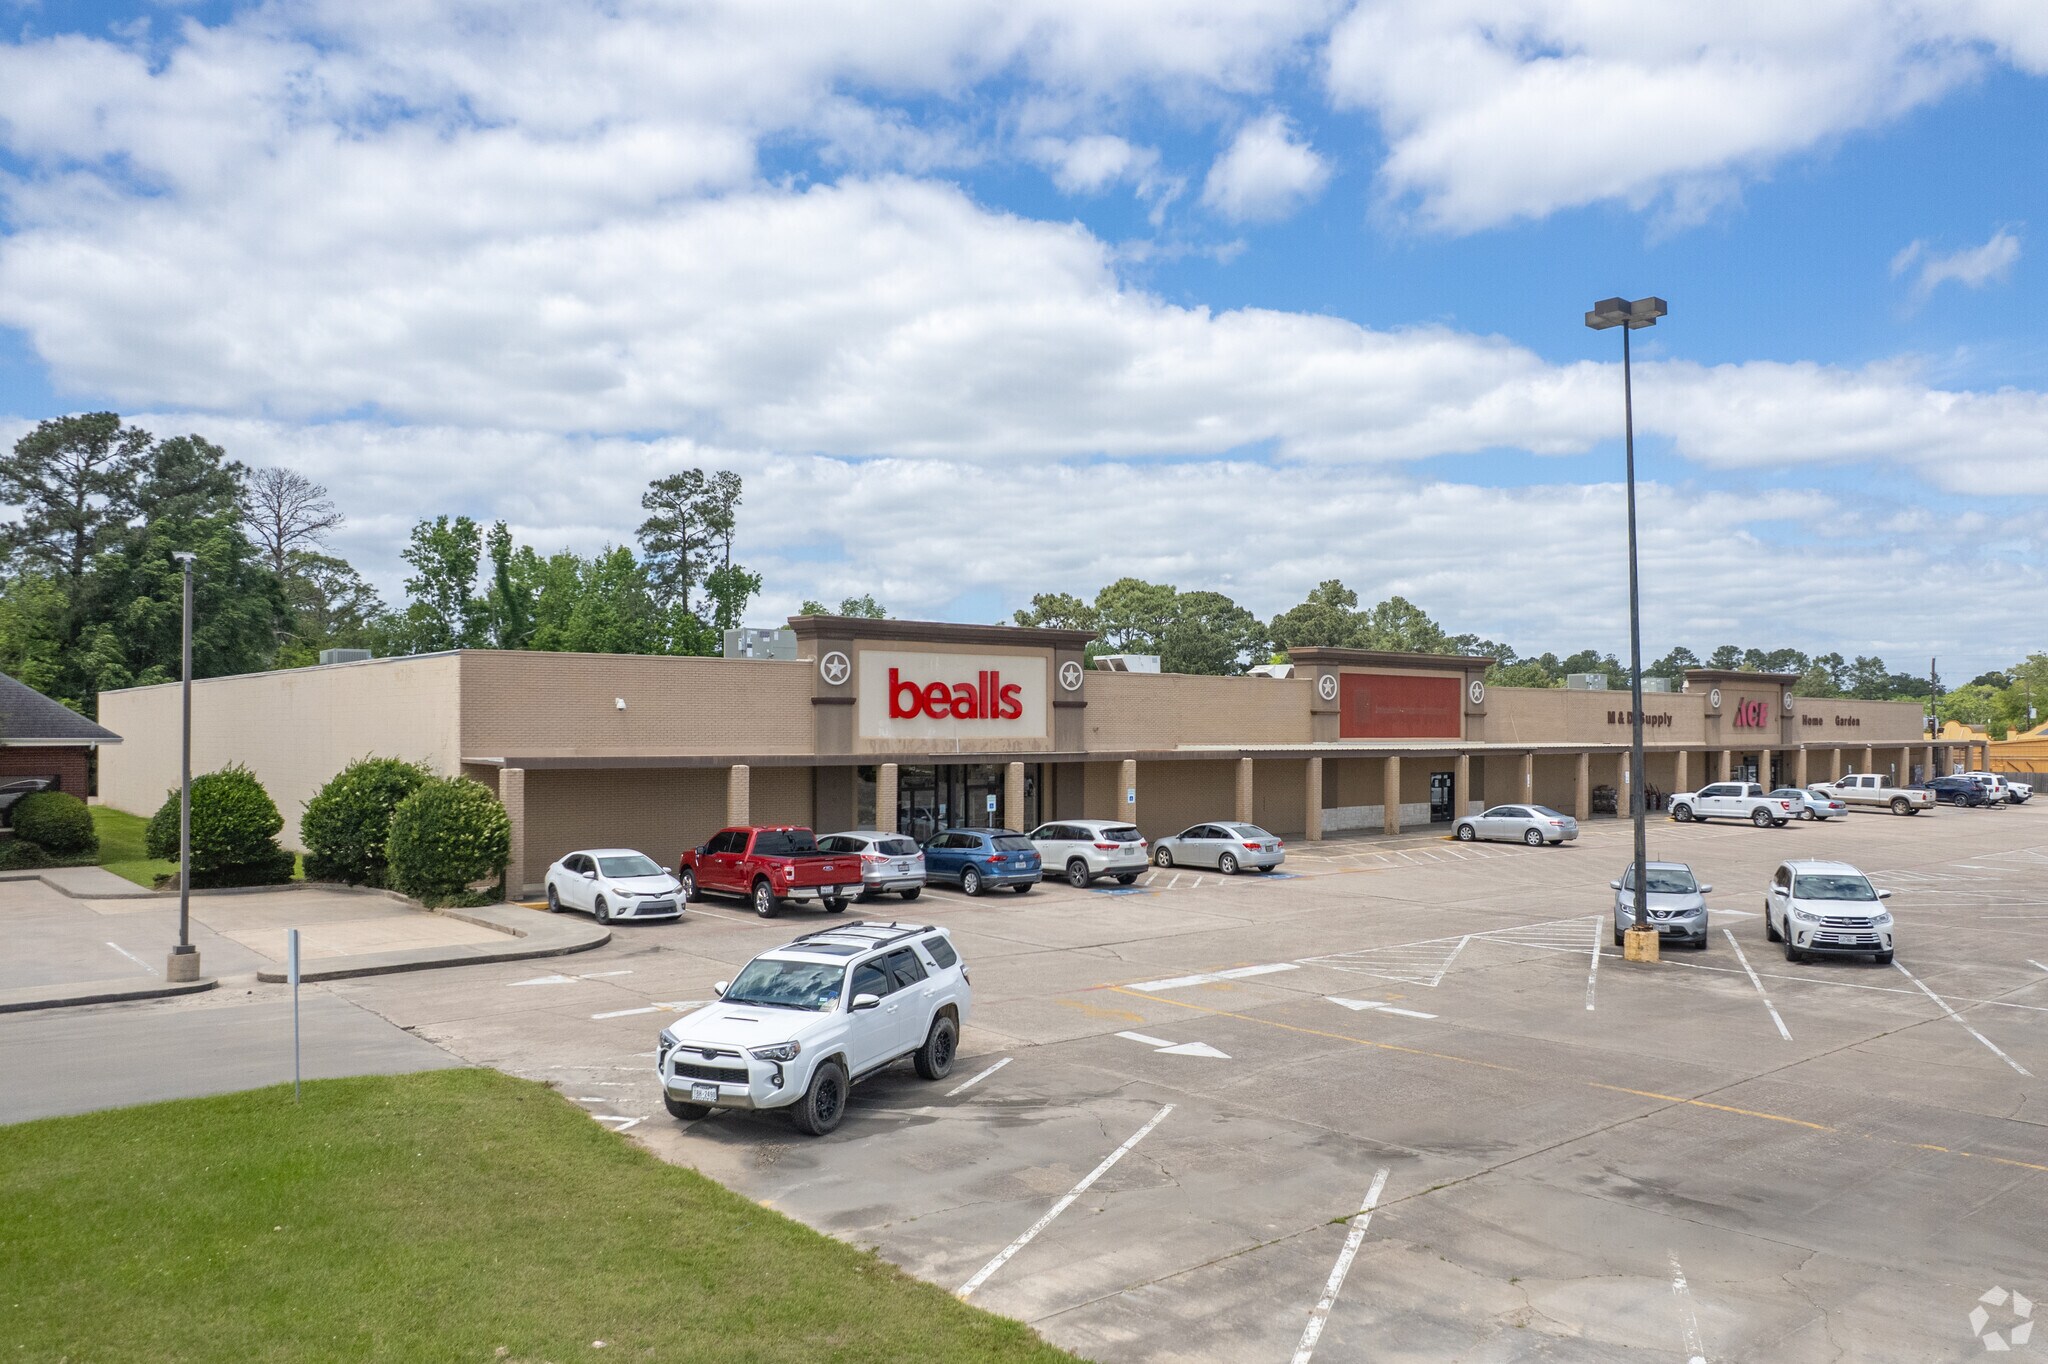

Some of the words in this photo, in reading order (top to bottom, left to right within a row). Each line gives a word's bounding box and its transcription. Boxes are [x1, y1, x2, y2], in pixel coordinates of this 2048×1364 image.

[888, 667, 1023, 720] bealls
[1607, 711, 1616, 724] M
[1617, 711, 1625, 724] &
[1732, 697, 1768, 728] ACE
[1802, 714, 1823, 726] Home
[1834, 714, 1860, 726] Garden
